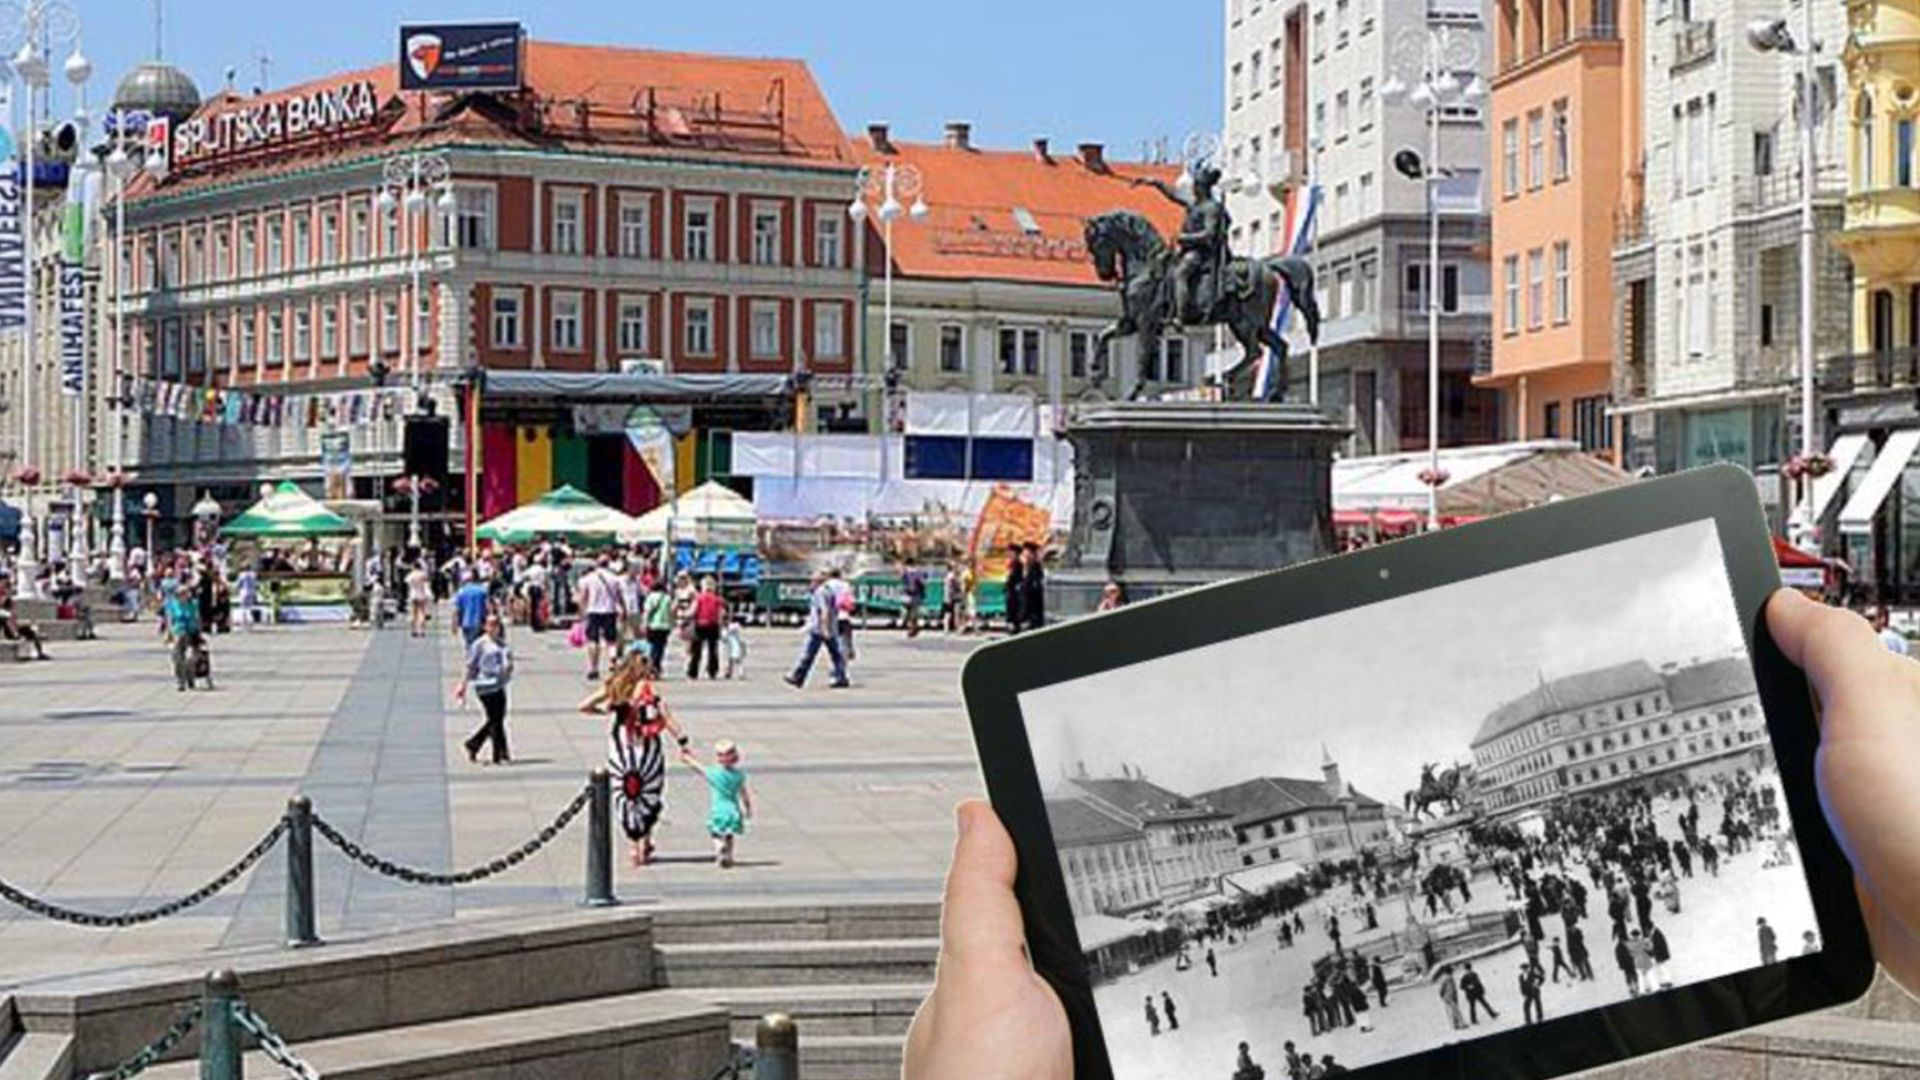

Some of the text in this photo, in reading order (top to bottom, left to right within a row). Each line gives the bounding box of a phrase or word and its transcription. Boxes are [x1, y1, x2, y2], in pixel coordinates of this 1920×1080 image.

[174, 81, 374, 158] SPLITSKA BANKA
[61, 258, 84, 392] ANIMAFEST
